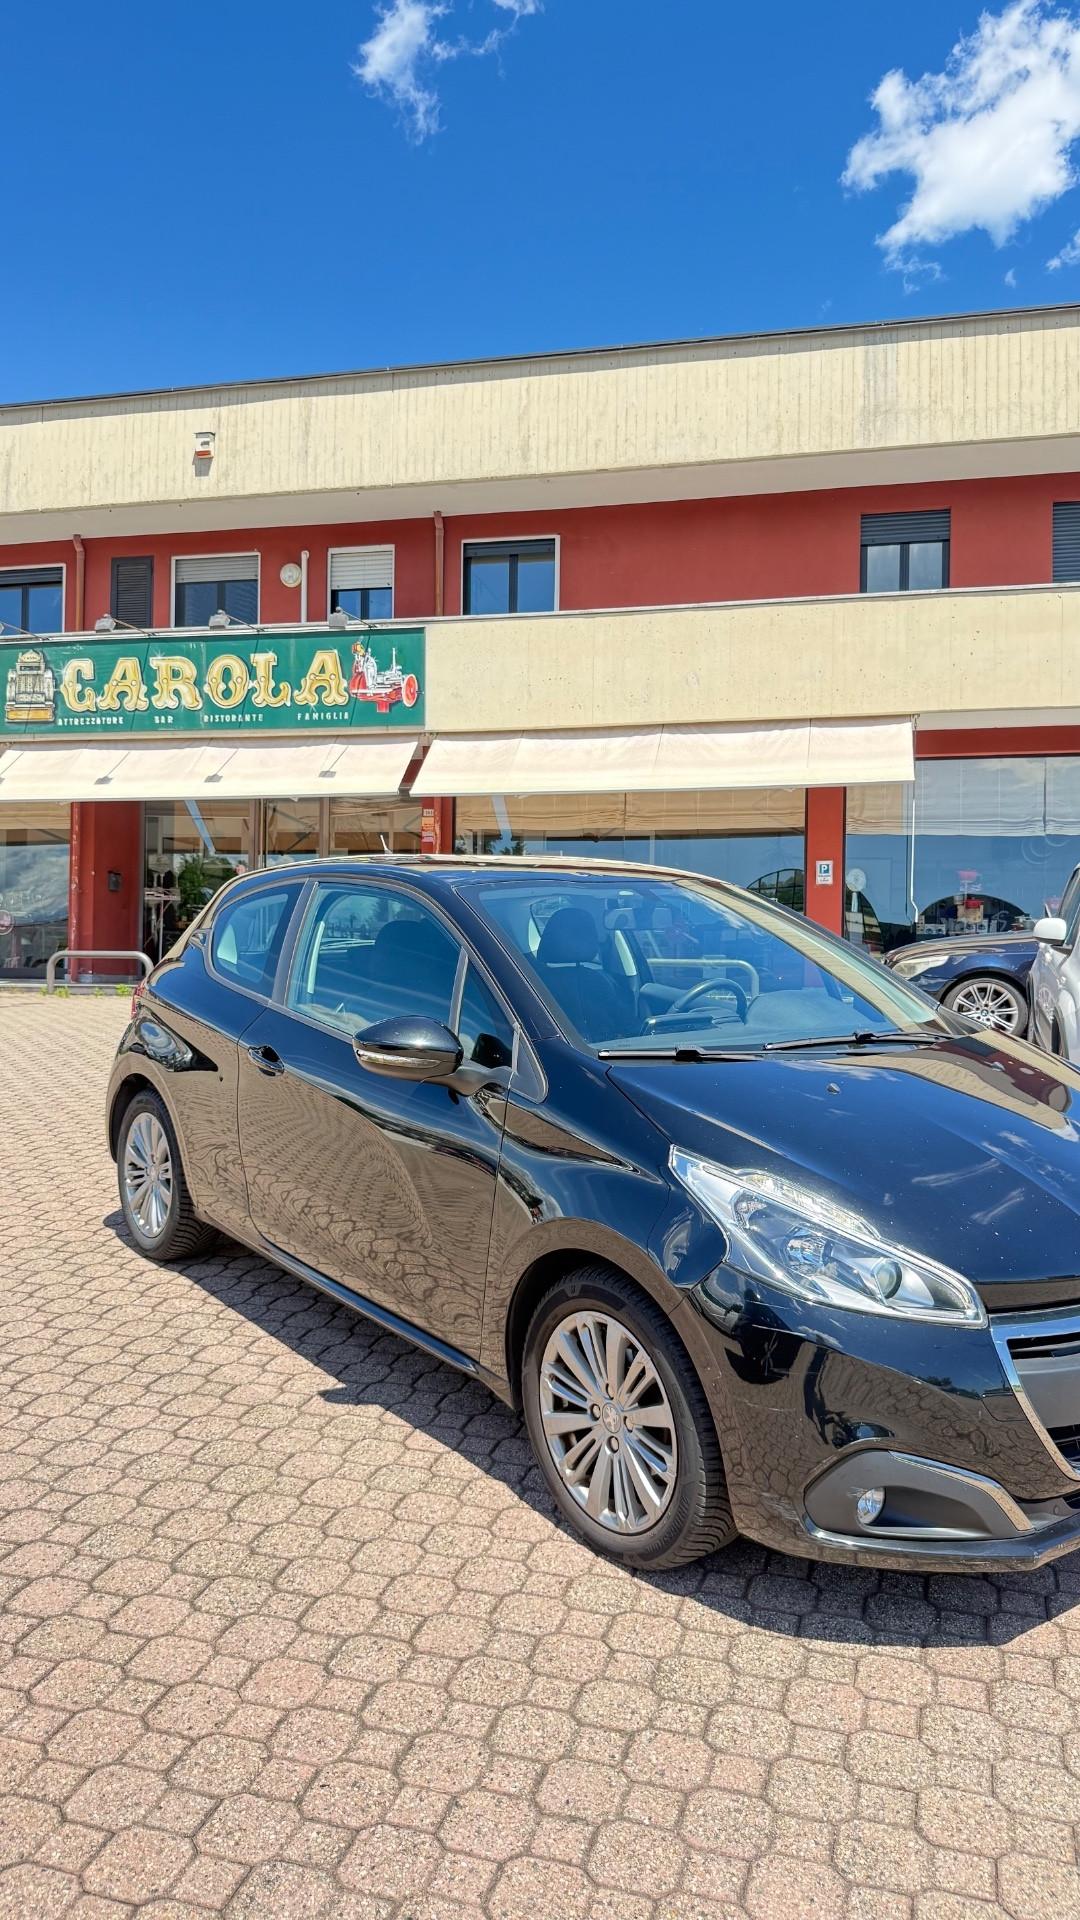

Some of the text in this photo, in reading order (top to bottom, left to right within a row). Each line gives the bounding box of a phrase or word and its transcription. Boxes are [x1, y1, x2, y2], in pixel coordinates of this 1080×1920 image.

[61, 650, 349, 712] CAROLA
[57, 712, 349, 726] ATTREZZATURE BAR RISTORANTE FAMIGLIA
